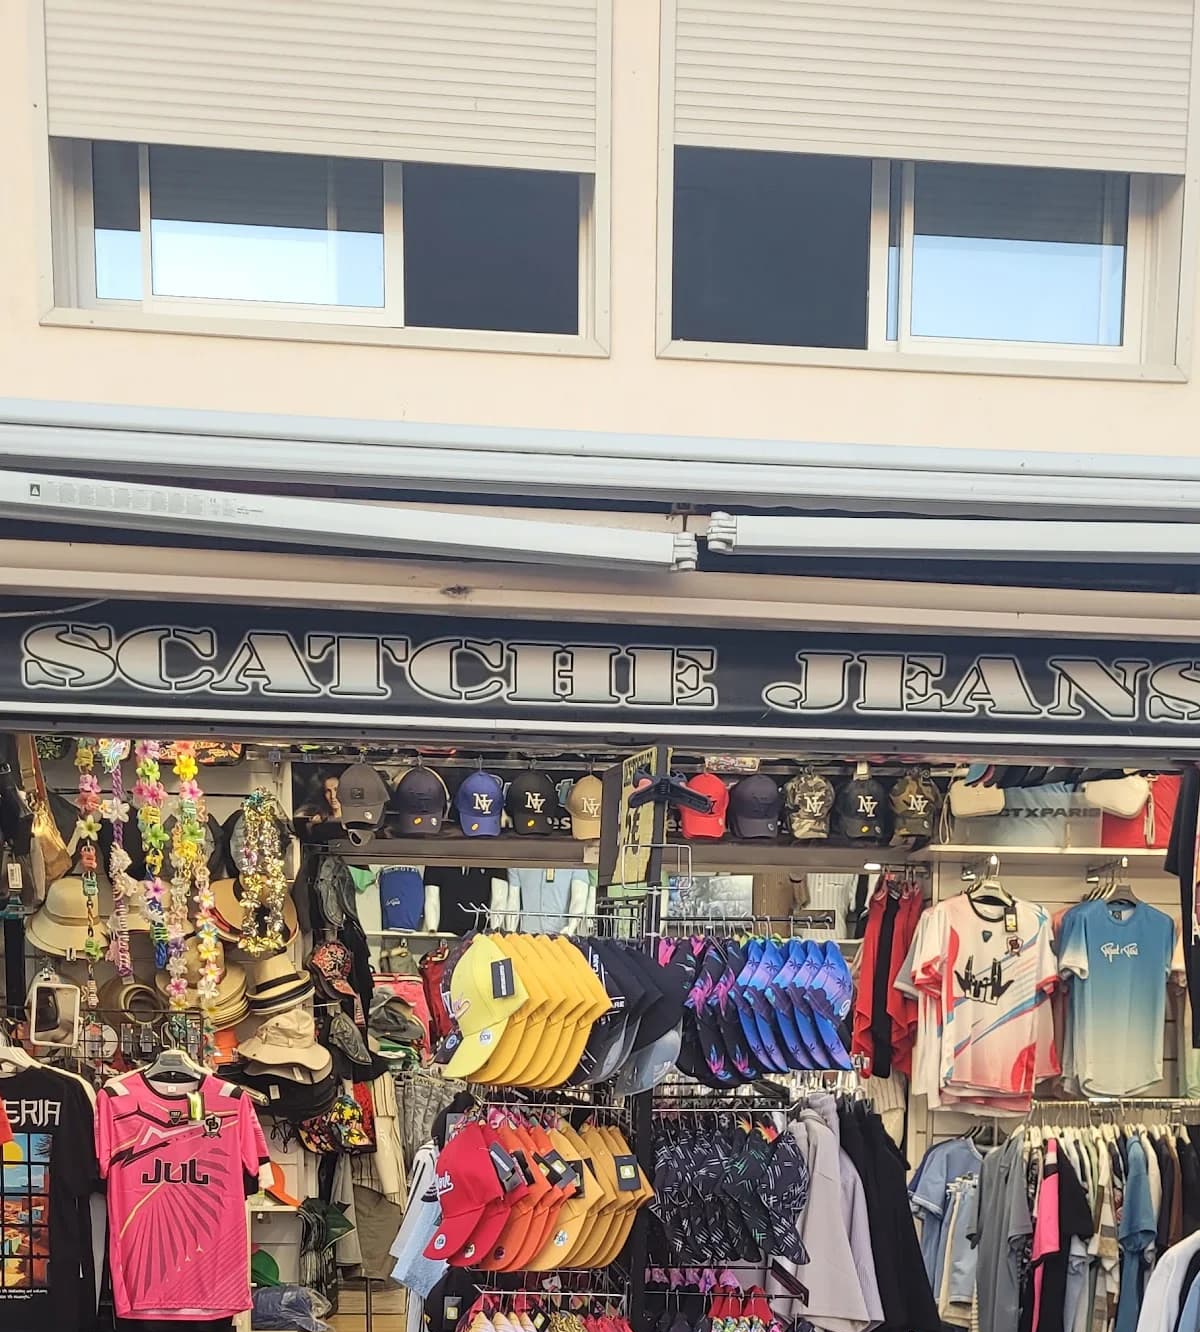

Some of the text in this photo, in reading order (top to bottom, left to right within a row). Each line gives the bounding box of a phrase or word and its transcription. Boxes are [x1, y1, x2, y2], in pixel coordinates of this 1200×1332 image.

[22, 623, 1200, 722] SCATCHE JEANS
[472, 793, 494, 814] NY
[524, 791, 546, 813] NY
[803, 796, 825, 816] NY
[856, 795, 878, 817] NY
[908, 794, 929, 815] NY
